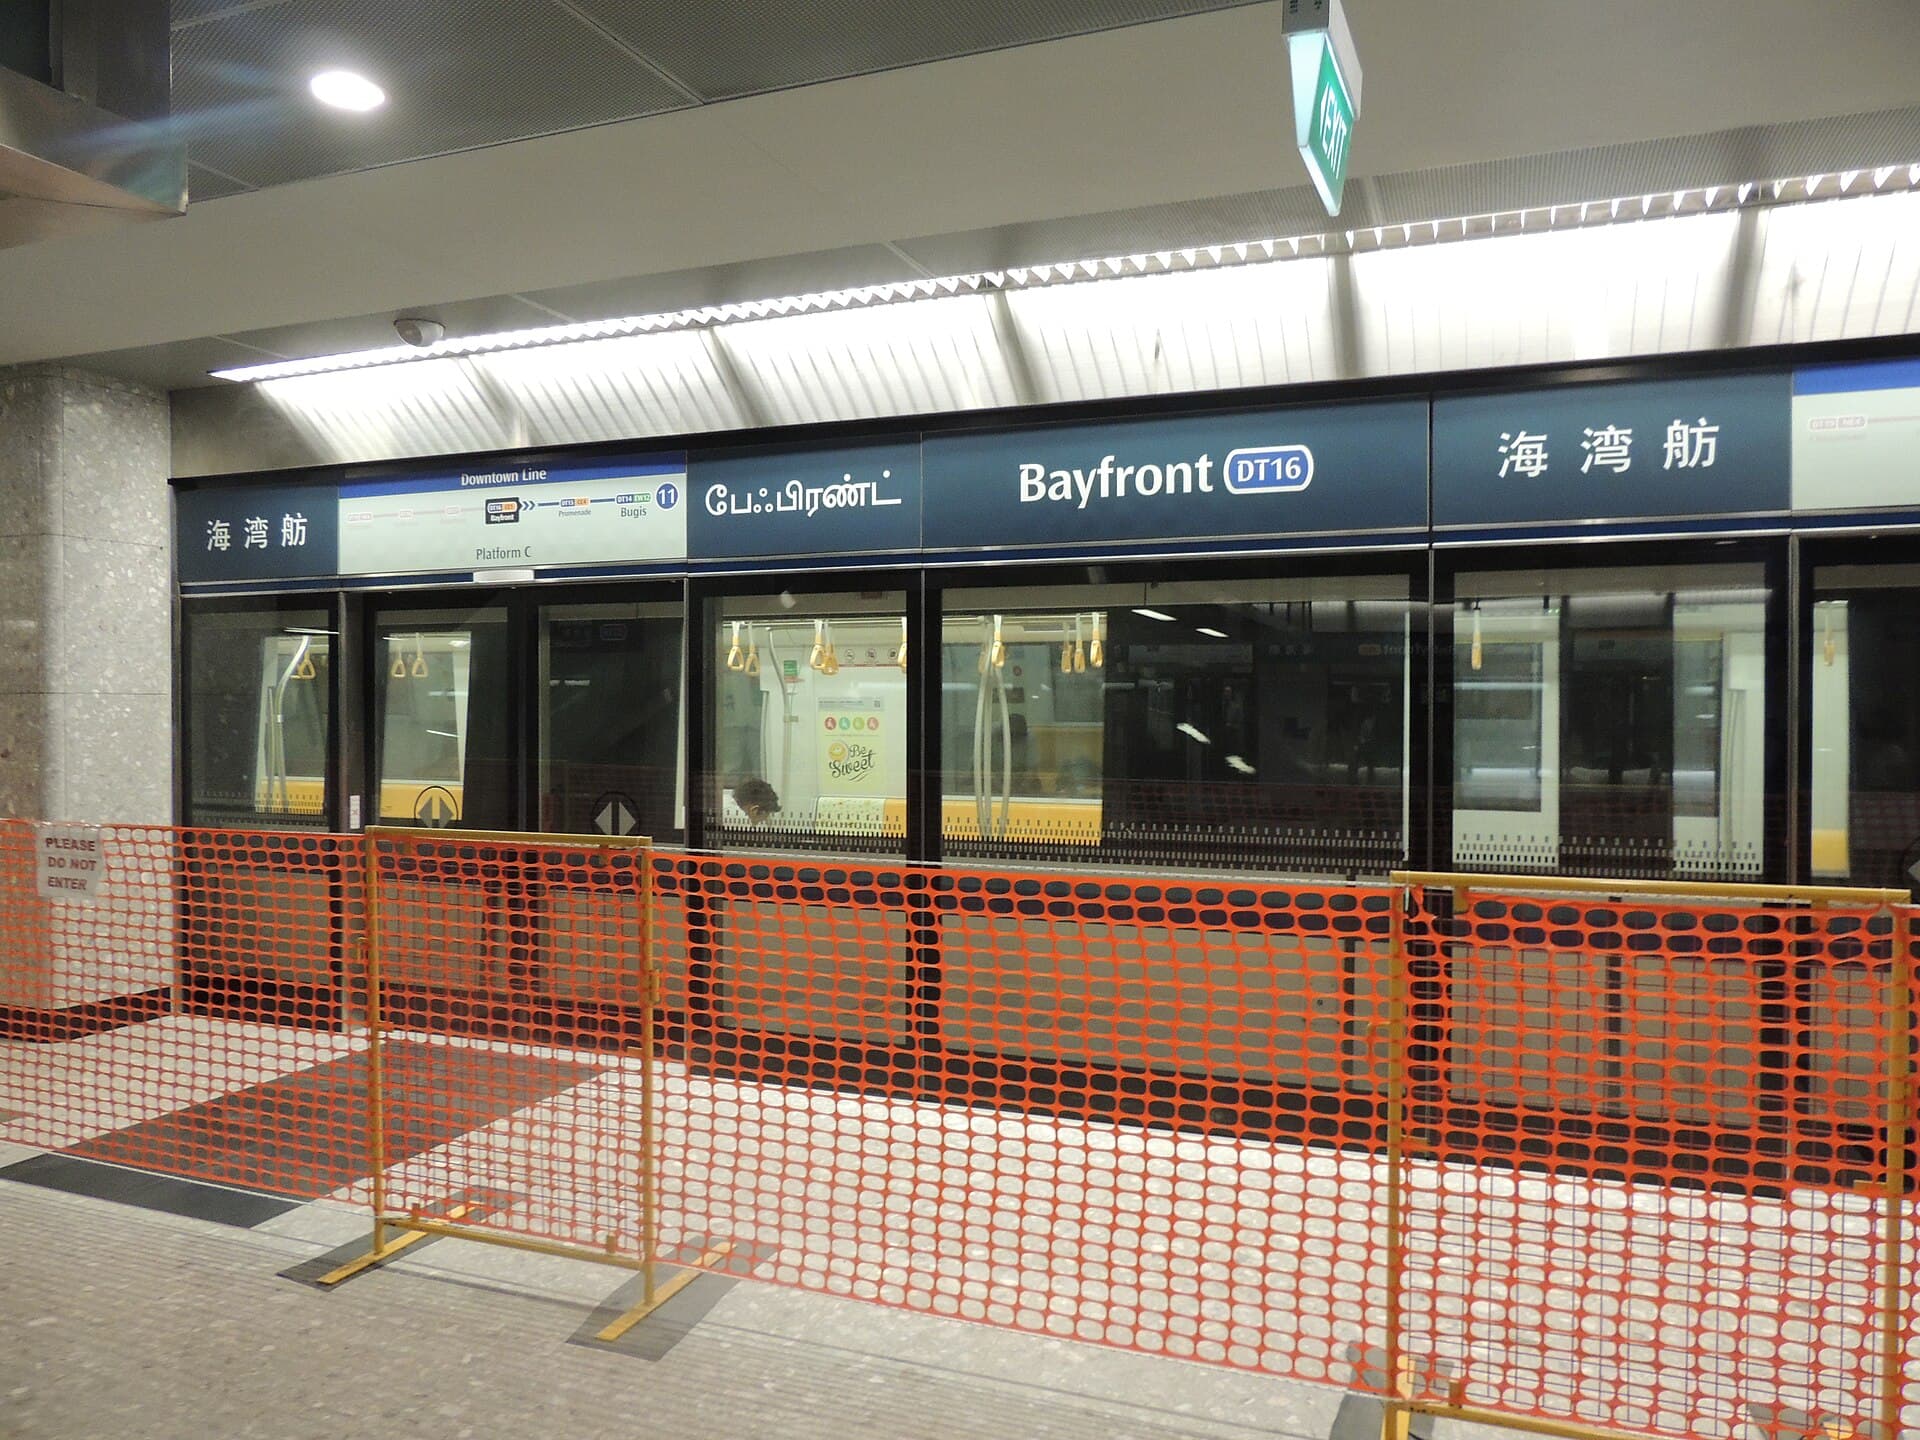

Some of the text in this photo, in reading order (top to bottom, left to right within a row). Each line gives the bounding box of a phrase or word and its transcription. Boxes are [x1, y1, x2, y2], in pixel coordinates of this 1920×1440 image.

[1322, 85, 1347, 179] EXIT
[1498, 417, 1719, 478] 海湾舫
[461, 467, 547, 486] Downtown Line
[1019, 454, 1302, 509] Bayfront DT16
[658, 488, 675, 505] 11
[705, 470, 902, 517] பேஃபிரண்ட்
[621, 505, 647, 518] Bugis
[206, 513, 308, 551] 海湾舫
[476, 545, 533, 560] Platform C
[849, 744, 867, 758] Be
[829, 750, 876, 778] Sweet
[45, 837, 96, 851] PLEASE
[48, 857, 97, 871] DO NOT
[48, 876, 88, 890] ENTER
